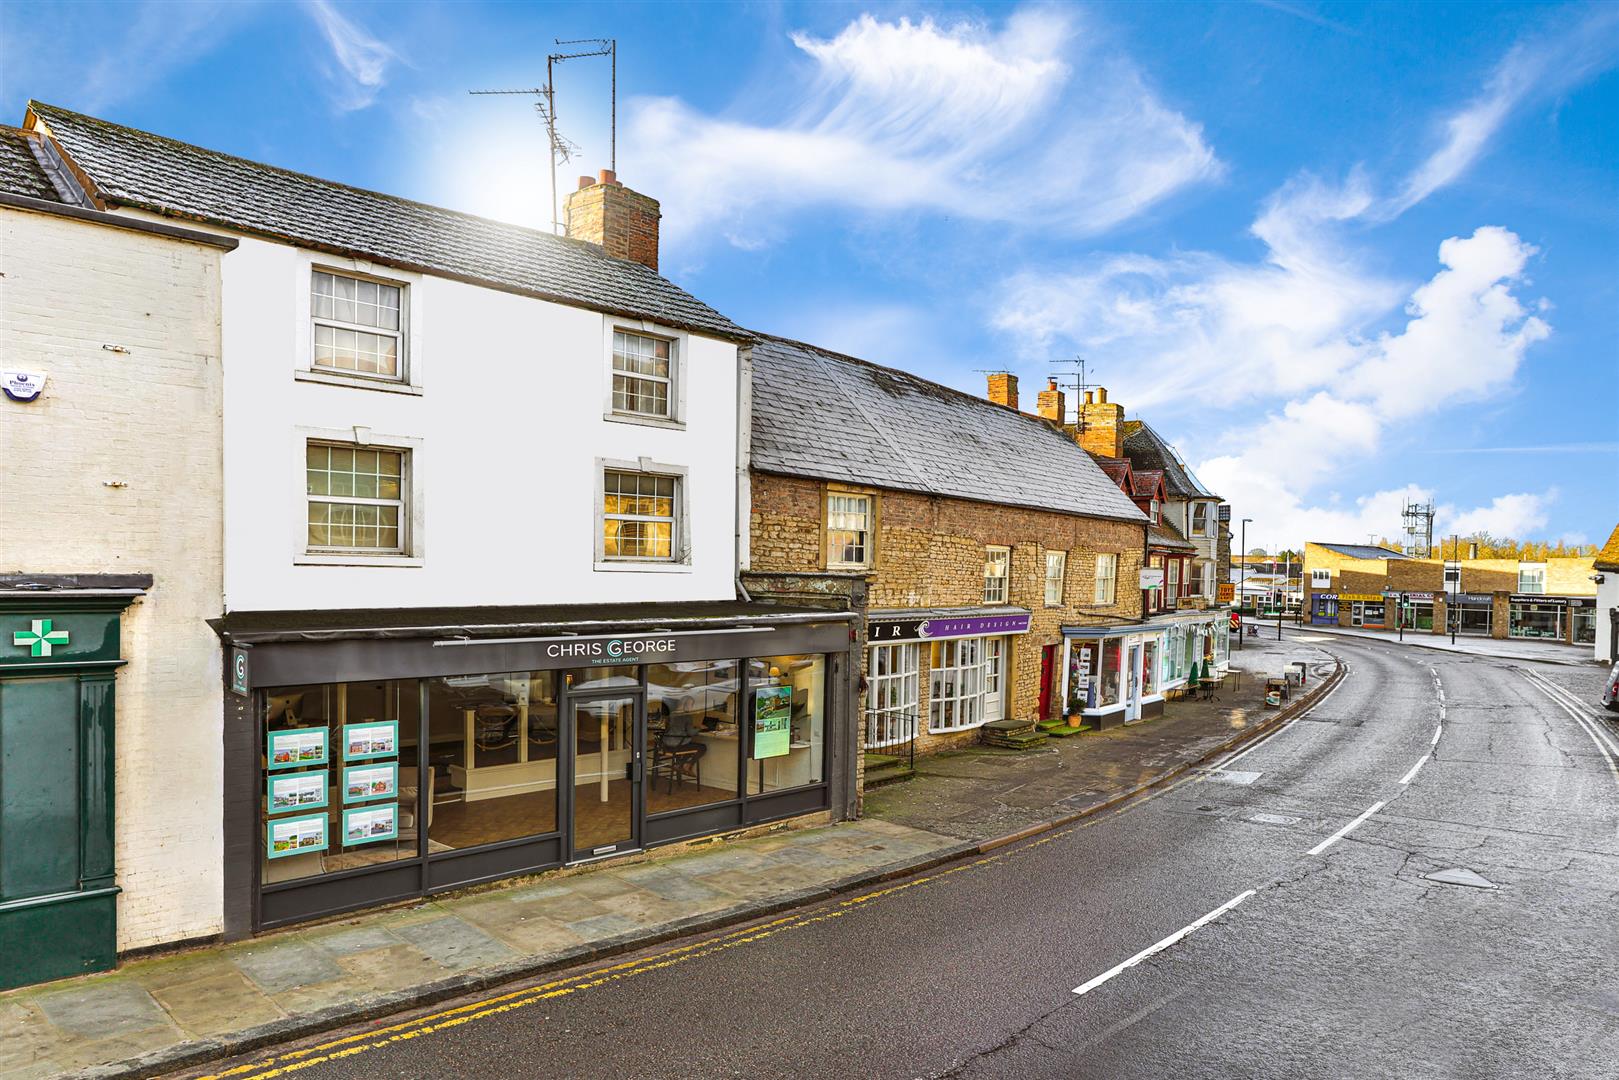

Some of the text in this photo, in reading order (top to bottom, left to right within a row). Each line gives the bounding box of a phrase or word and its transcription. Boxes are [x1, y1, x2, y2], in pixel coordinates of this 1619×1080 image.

[945, 620, 1016, 631] HAIR DESIGN
[547, 640, 676, 657] CHRIS GEORGE
